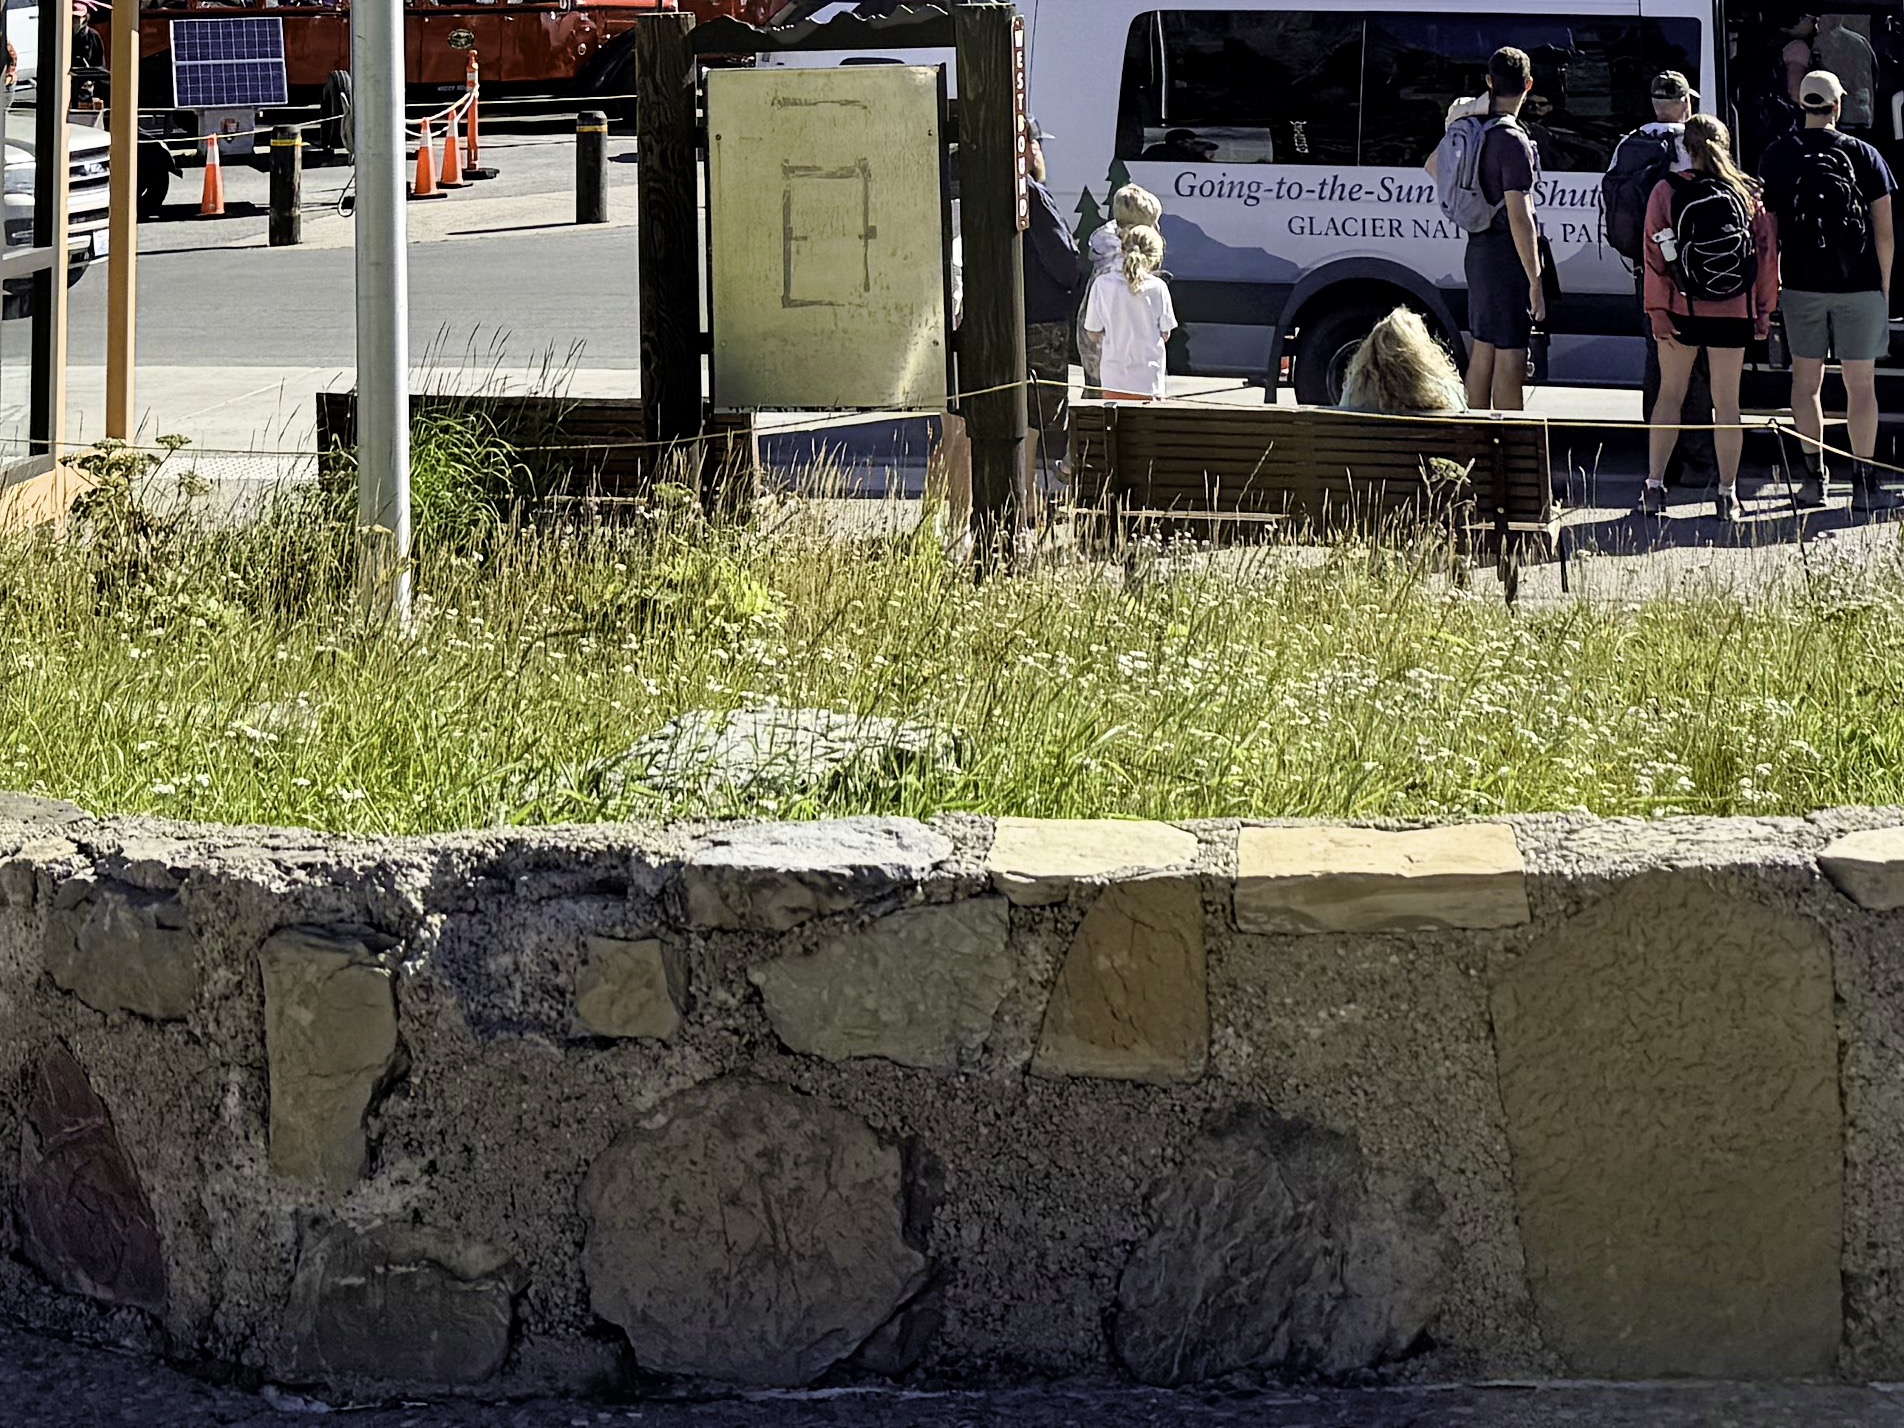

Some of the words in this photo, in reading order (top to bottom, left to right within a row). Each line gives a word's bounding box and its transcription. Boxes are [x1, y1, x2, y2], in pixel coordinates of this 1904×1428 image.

[1014, 29, 1028, 218] WESTBOUND
[1173, 171, 1435, 207] Going-to-the-Sun
[1534, 179, 1599, 208] Shut
[1287, 215, 1405, 239] GLACIER
